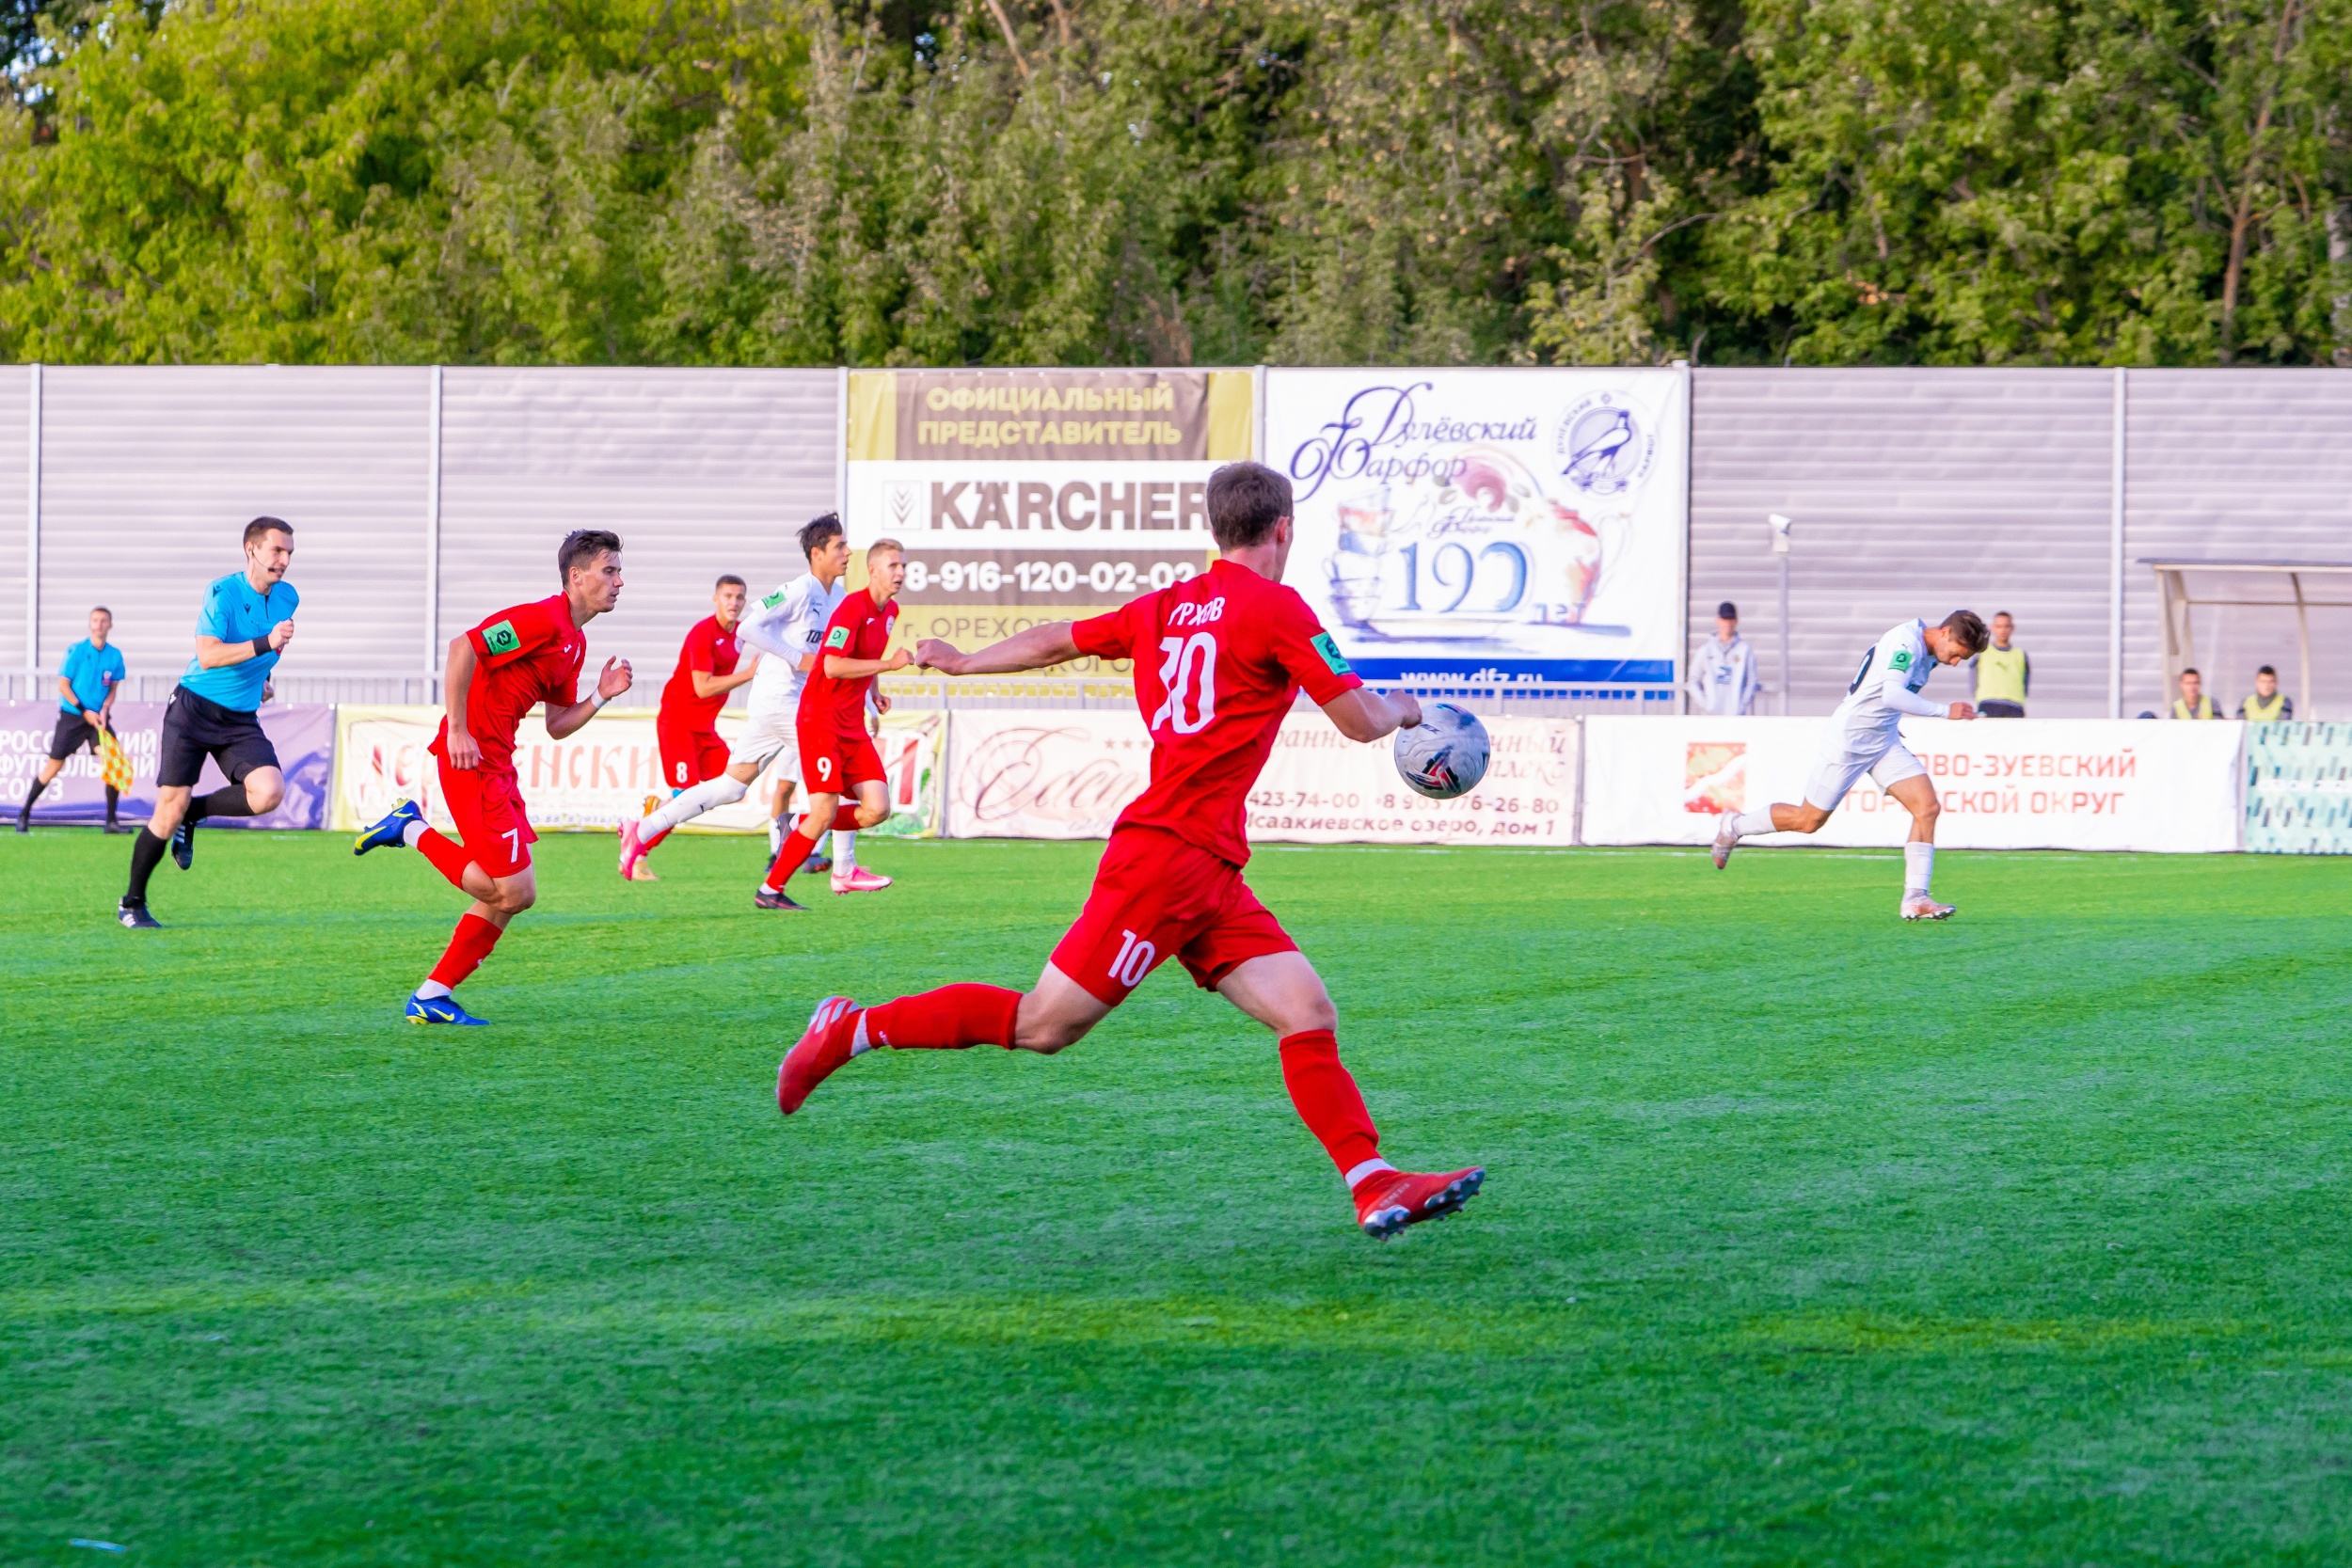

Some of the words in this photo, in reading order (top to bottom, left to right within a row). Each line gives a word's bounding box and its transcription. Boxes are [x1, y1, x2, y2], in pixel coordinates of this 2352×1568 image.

[926, 382, 1175, 413] ОФИЦИАЛЬНЫЙ
[917, 420, 1183, 449] ПРЕДСТАВИТЕЛЬ
[930, 481, 1211, 531] KÄRCHER
[905, 562, 1197, 594] 8-916-120-02-02
[1151, 632, 1217, 735] 10
[1400, 668, 1544, 681] wwwdfzru
[675, 761, 689, 784] 8
[816, 756, 833, 783] 9
[1844, 784, 2020, 814] ГОРСКОЙ
[2030, 791, 2125, 815] ОКРУГ
[1490, 822, 1538, 836] дом
[1546, 820, 1555, 835] 1
[501, 828, 519, 863] 7
[1107, 928, 1156, 988] 10
